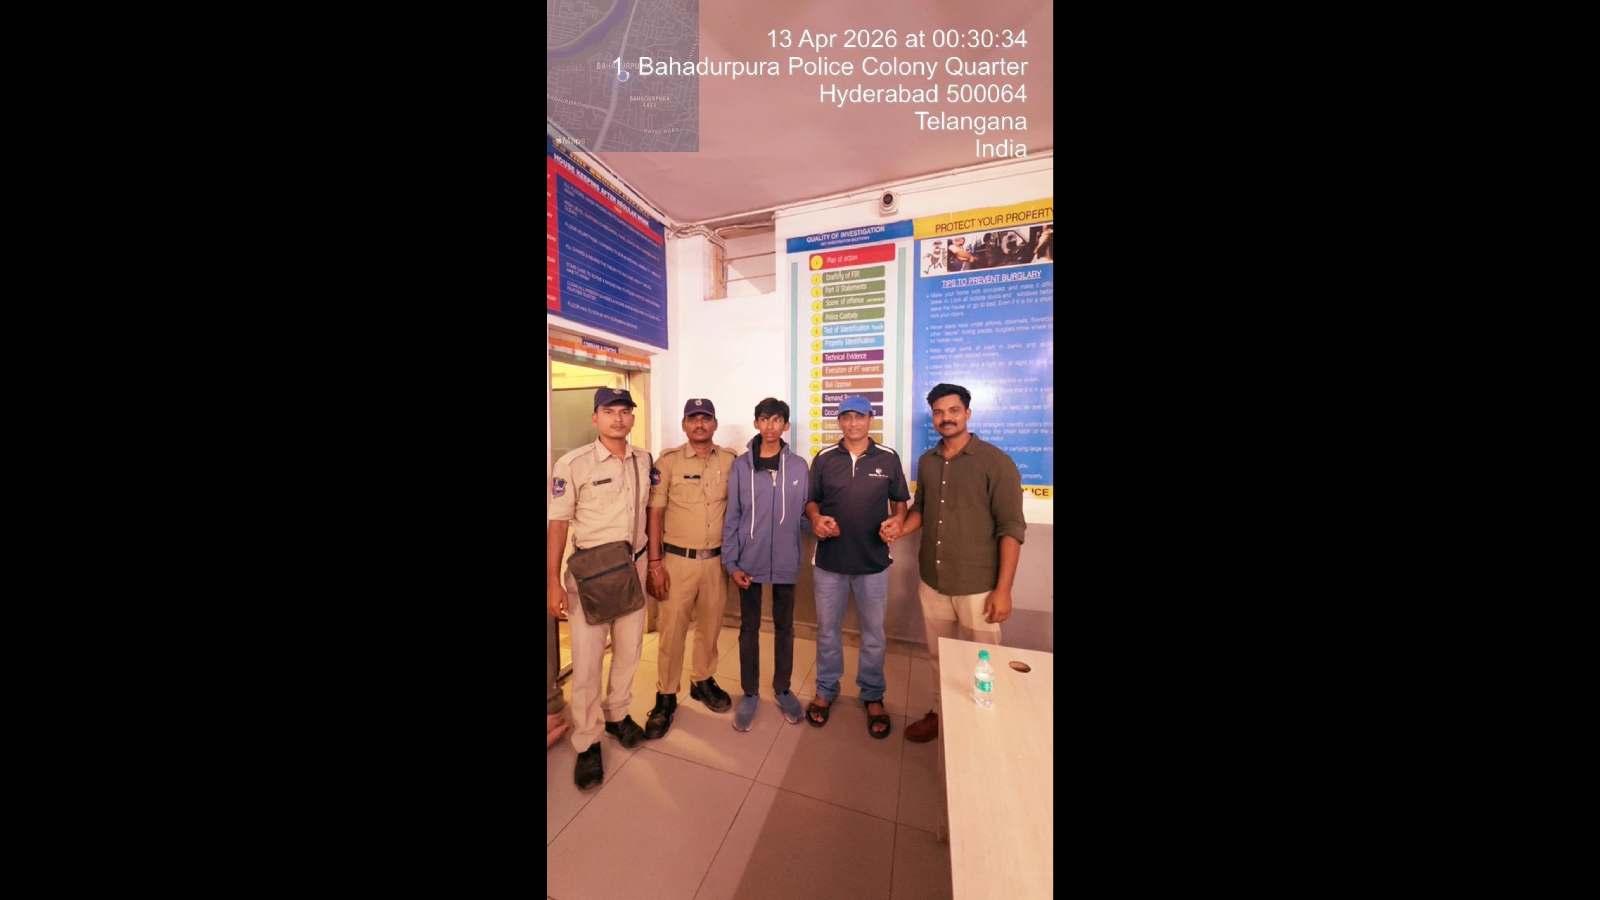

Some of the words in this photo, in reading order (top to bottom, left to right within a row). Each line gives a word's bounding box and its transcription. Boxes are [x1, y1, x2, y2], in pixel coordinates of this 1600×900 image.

[935, 218, 976, 233] PROTECT
[977, 214, 1003, 226] YOUR
[806, 234, 830, 243] QUALITY
[831, 232, 838, 240] OF
[840, 226, 885, 238] INVESTIGATION
[958, 278, 968, 287] TO
[968, 275, 1000, 286] PREVENT
[1001, 270, 1042, 281] BURGLARY
[825, 353, 845, 361] Technical
[846, 352, 867, 360] Evidence
